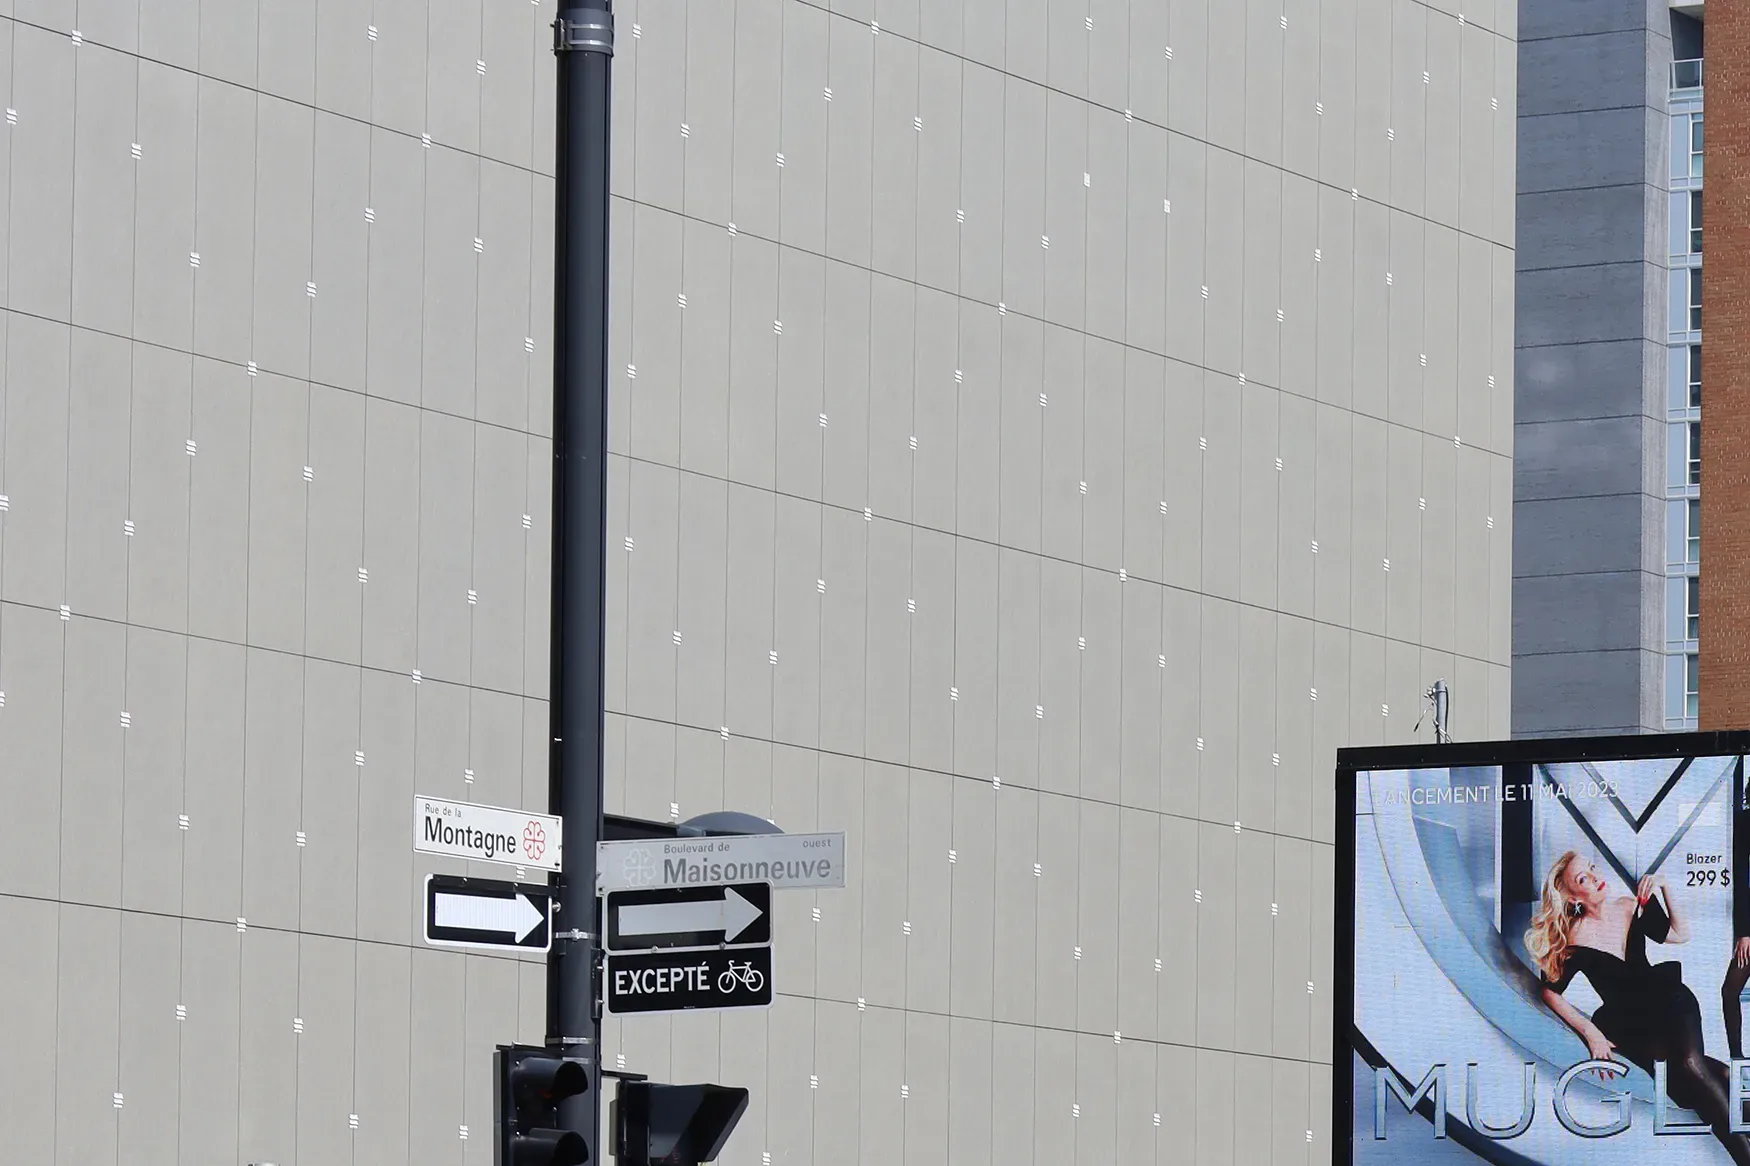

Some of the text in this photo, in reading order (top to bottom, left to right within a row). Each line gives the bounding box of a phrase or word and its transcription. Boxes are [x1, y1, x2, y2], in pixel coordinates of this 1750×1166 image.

[1495, 784, 1516, 801] LE
[1520, 784, 1533, 800] 11
[1578, 781, 1619, 799] 2023
[424, 803, 462, 818] Rue de la
[424, 815, 517, 858] Montagne
[802, 839, 832, 849] ouest
[663, 842, 731, 855] Boulevard de
[1686, 853, 1723, 865] Blazer
[663, 858, 831, 885] Maisonneuve
[1686, 867, 1731, 888] 299 $
[614, 961, 711, 996] EXCEPTÉ
